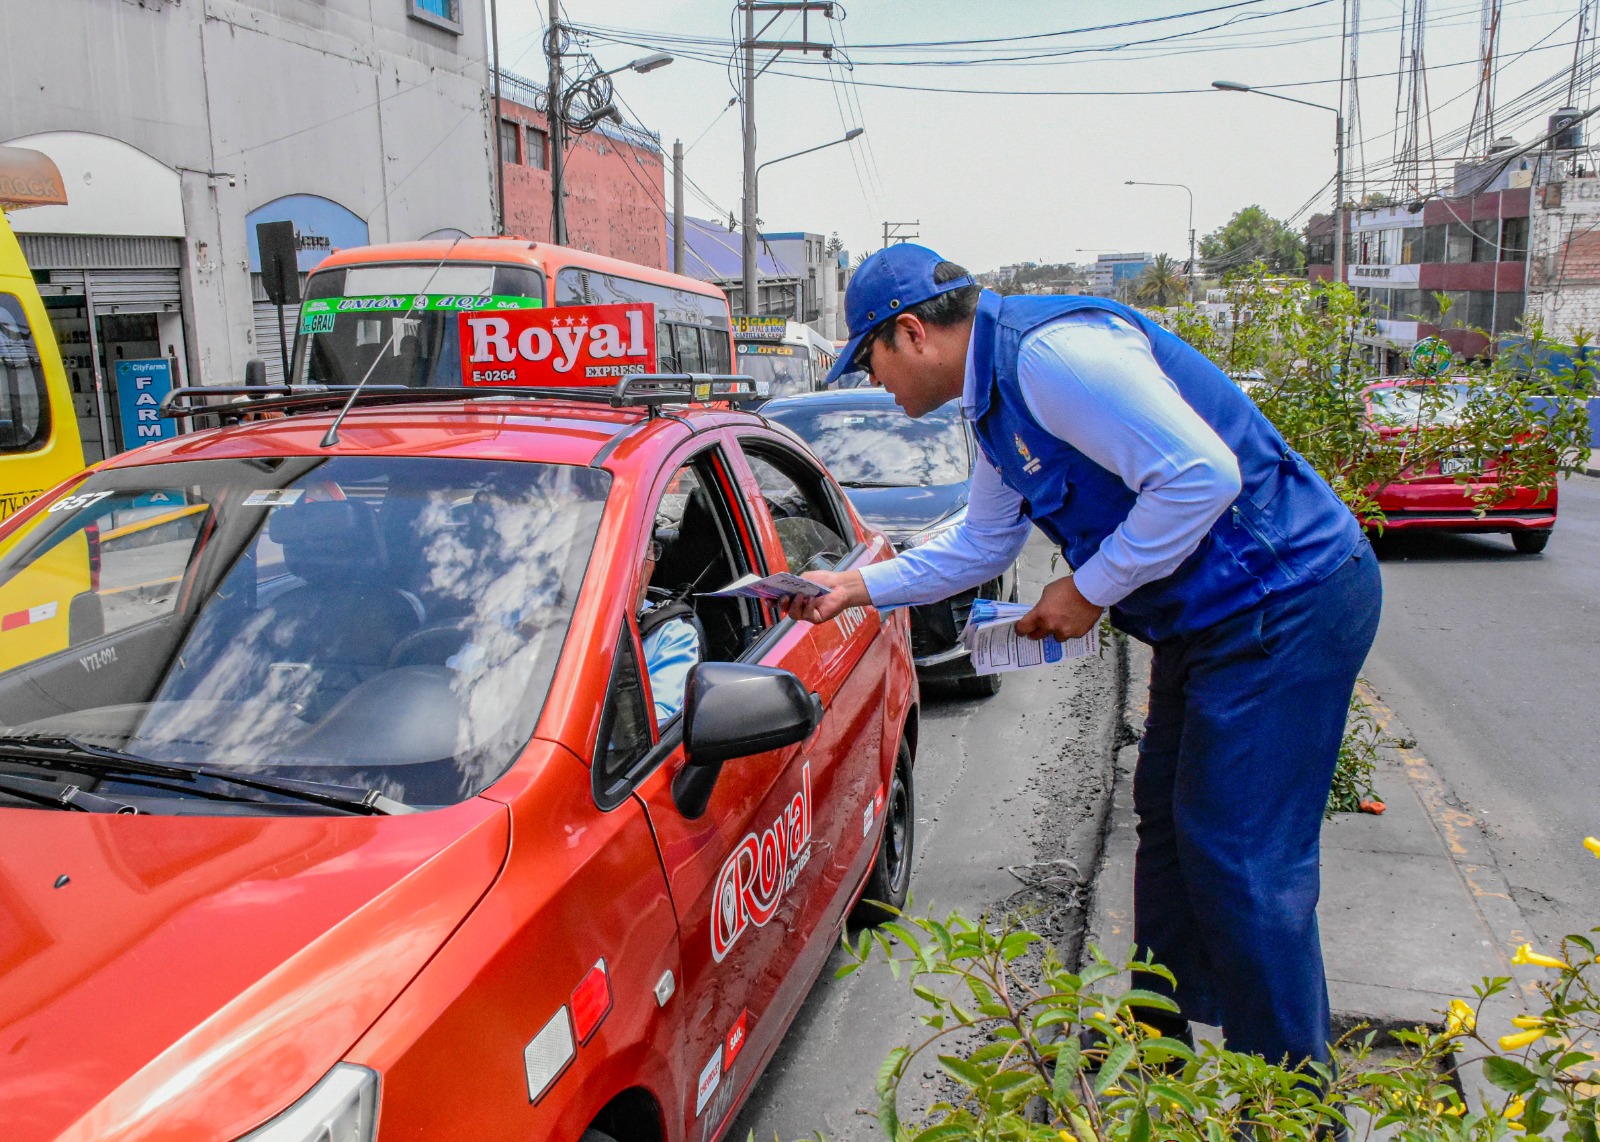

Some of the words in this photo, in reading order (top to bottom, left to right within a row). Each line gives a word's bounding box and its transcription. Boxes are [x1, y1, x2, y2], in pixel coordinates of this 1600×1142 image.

[337, 296, 406, 310] UNIÓN
[436, 296, 493, 309] AQP
[312, 314, 335, 331] GRAU
[467, 310, 648, 373] Royal
[132, 363, 167, 372] CityFarma
[472, 369, 517, 382] E-0264
[585, 364, 646, 378] EXPRESS
[135, 376, 162, 446] FARM
[47, 490, 115, 513] 657
[711, 760, 812, 963] Royal
[729, 1026, 743, 1051] SAIL
[700, 1061, 720, 1097] CHEVROLET
